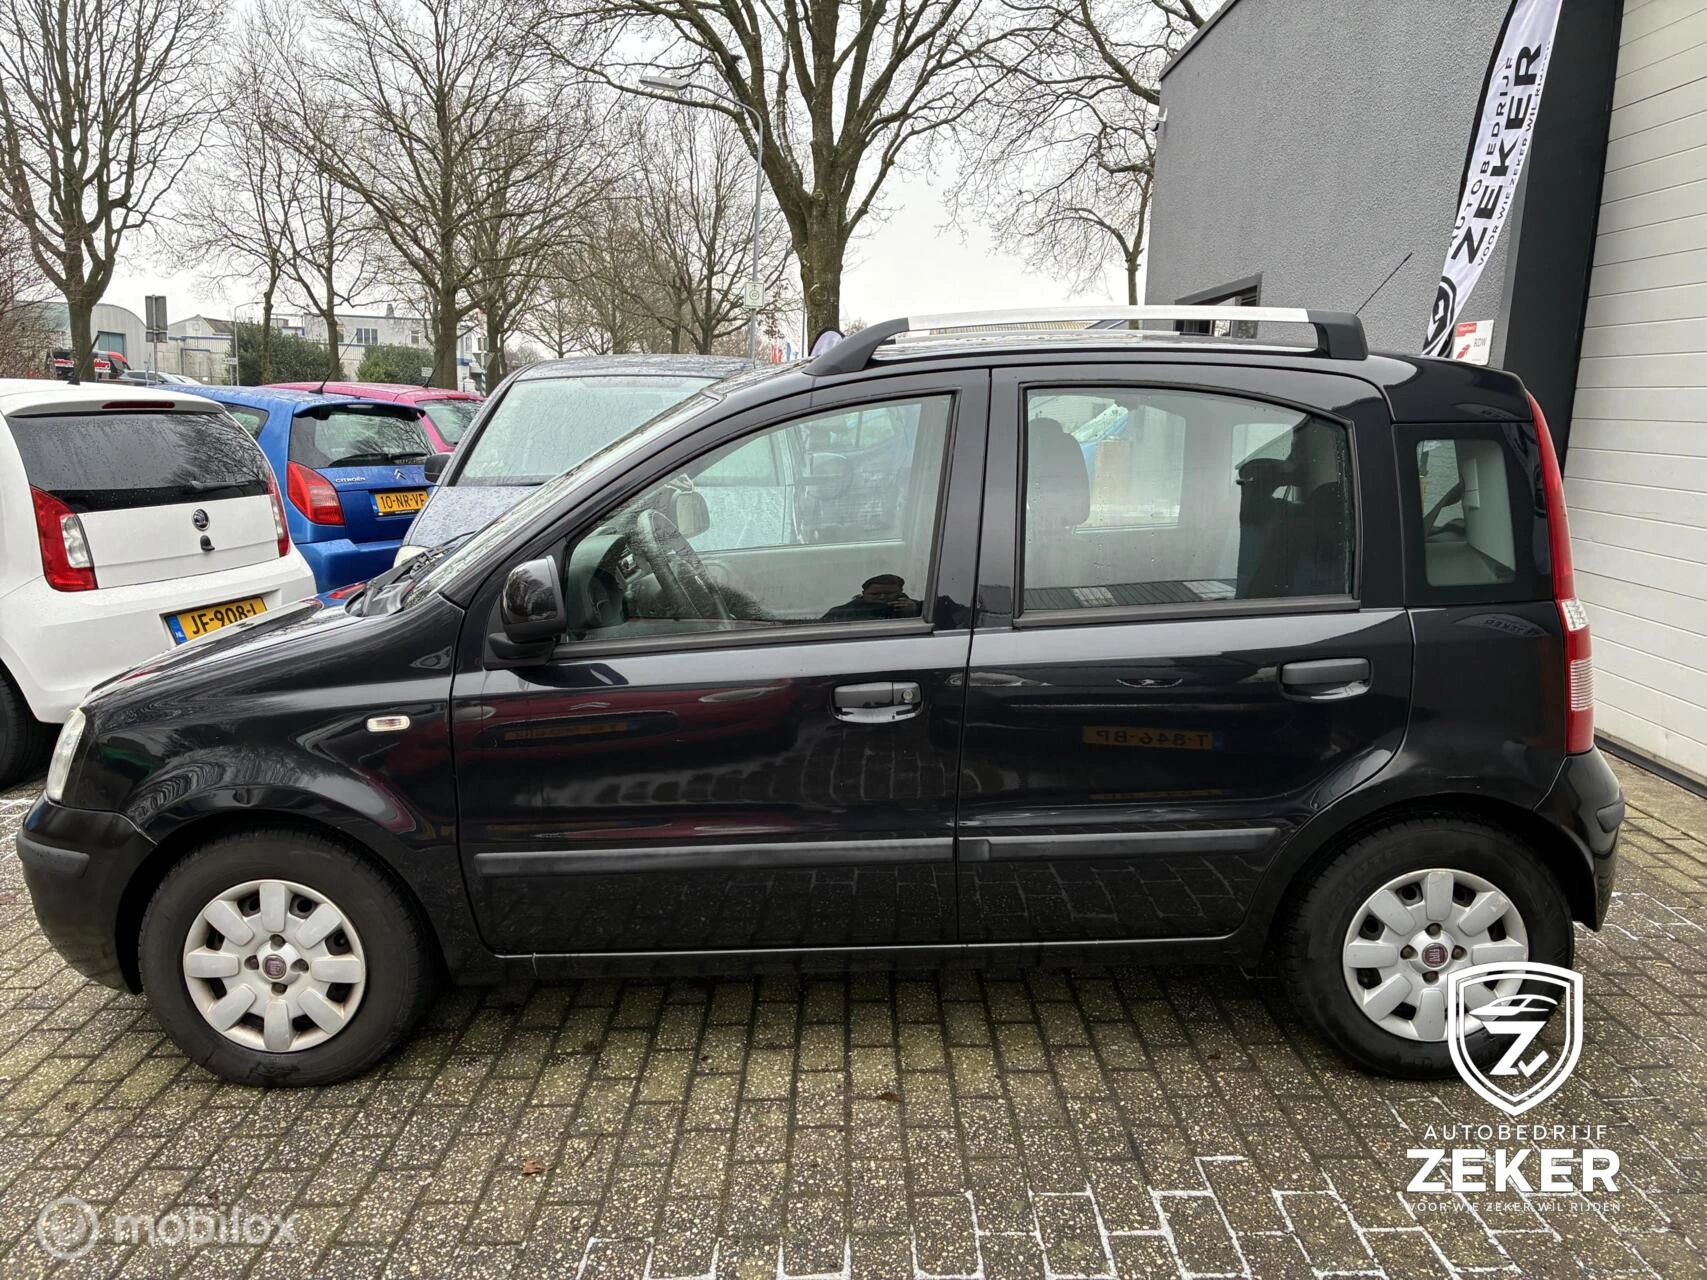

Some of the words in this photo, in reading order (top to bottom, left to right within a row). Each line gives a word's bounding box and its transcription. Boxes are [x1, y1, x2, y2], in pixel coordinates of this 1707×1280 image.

[1450, 57, 1512, 247] AUTOBEDRIJF
[1451, 43, 1542, 264] ZEKER
[1478, 225, 1499, 266] VOOR
[1497, 192, 1511, 219] WIE
